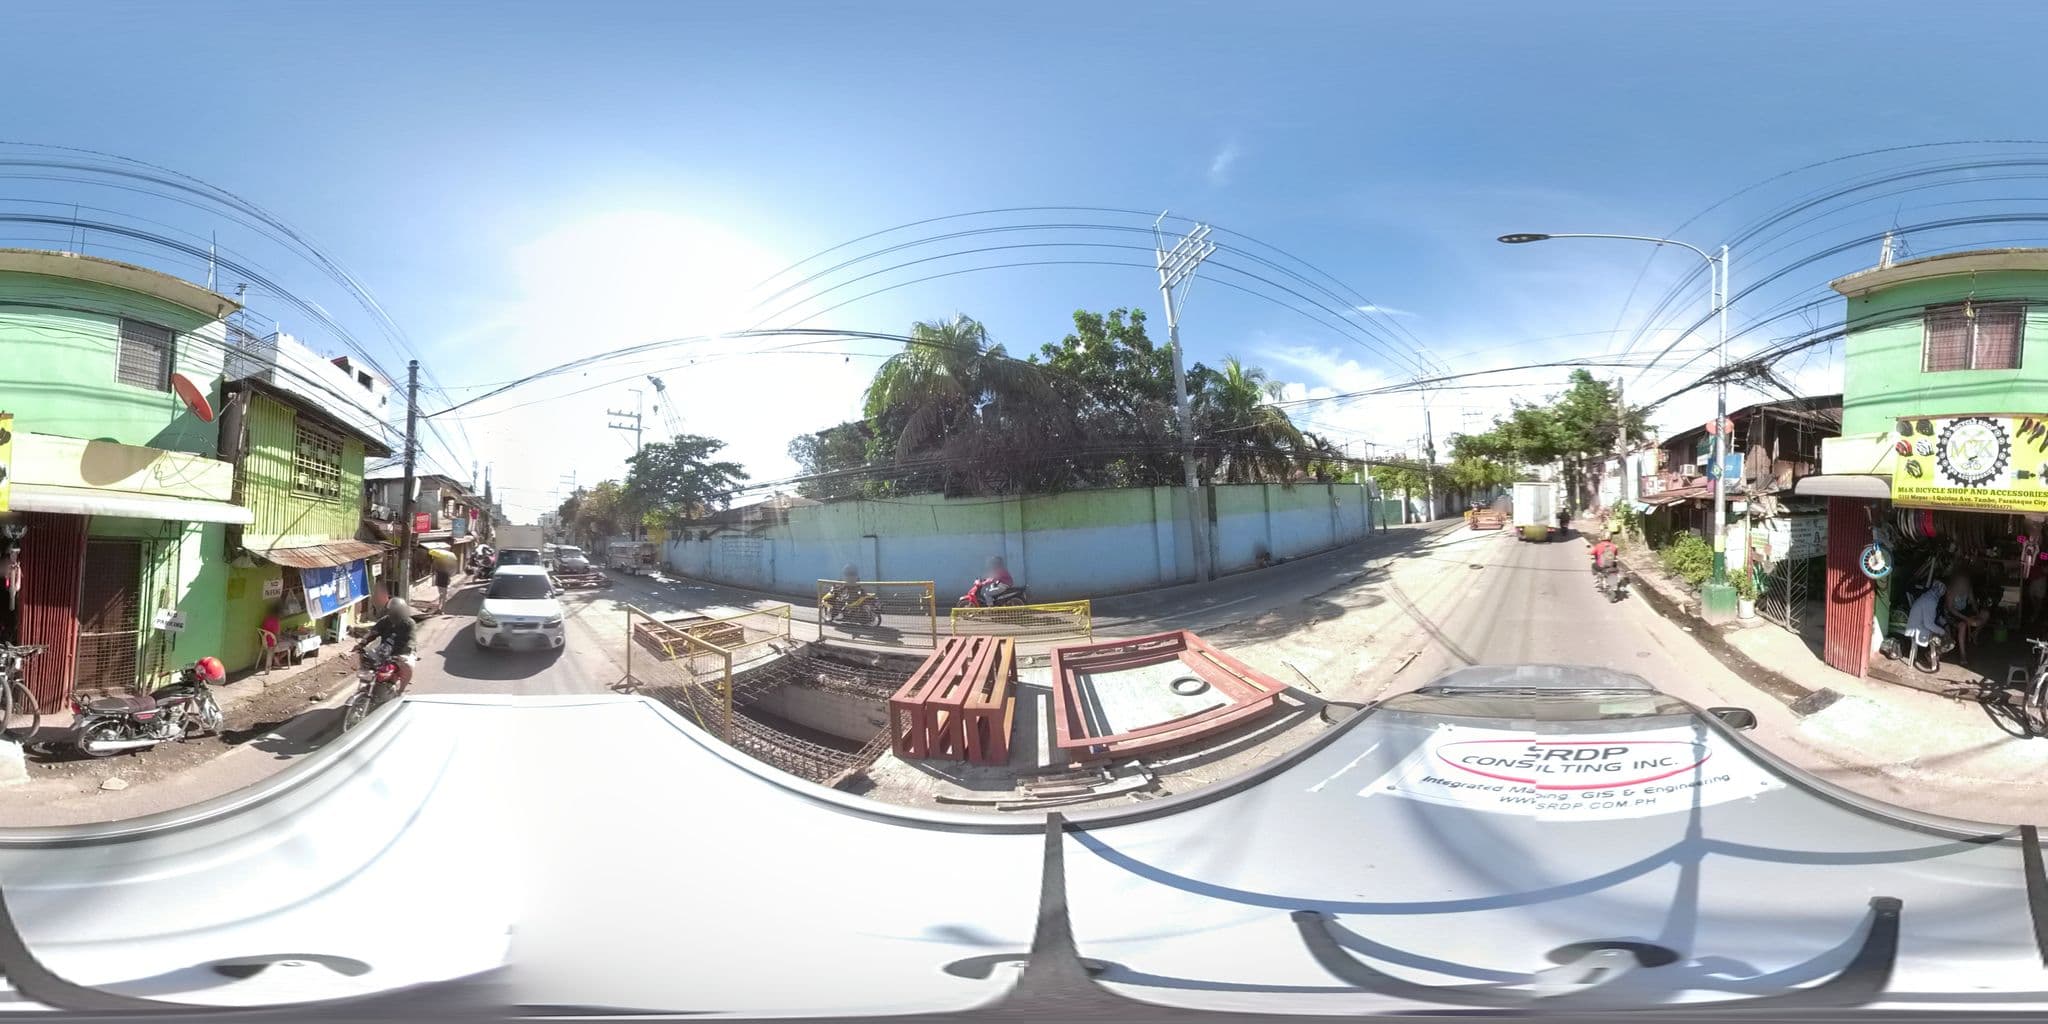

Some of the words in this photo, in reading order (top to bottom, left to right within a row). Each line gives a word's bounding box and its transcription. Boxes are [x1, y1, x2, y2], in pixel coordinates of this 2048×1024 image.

[1990, 489, 2048, 498] ACCESSORIES
[1523, 746, 1629, 761] SRDP
[1633, 757, 1678, 769] INC.
[1422, 775, 1503, 791] Integrated
[1581, 791, 1614, 799] GIS
[1623, 789, 1635, 797] &
[1643, 774, 1731, 794] Engineering
